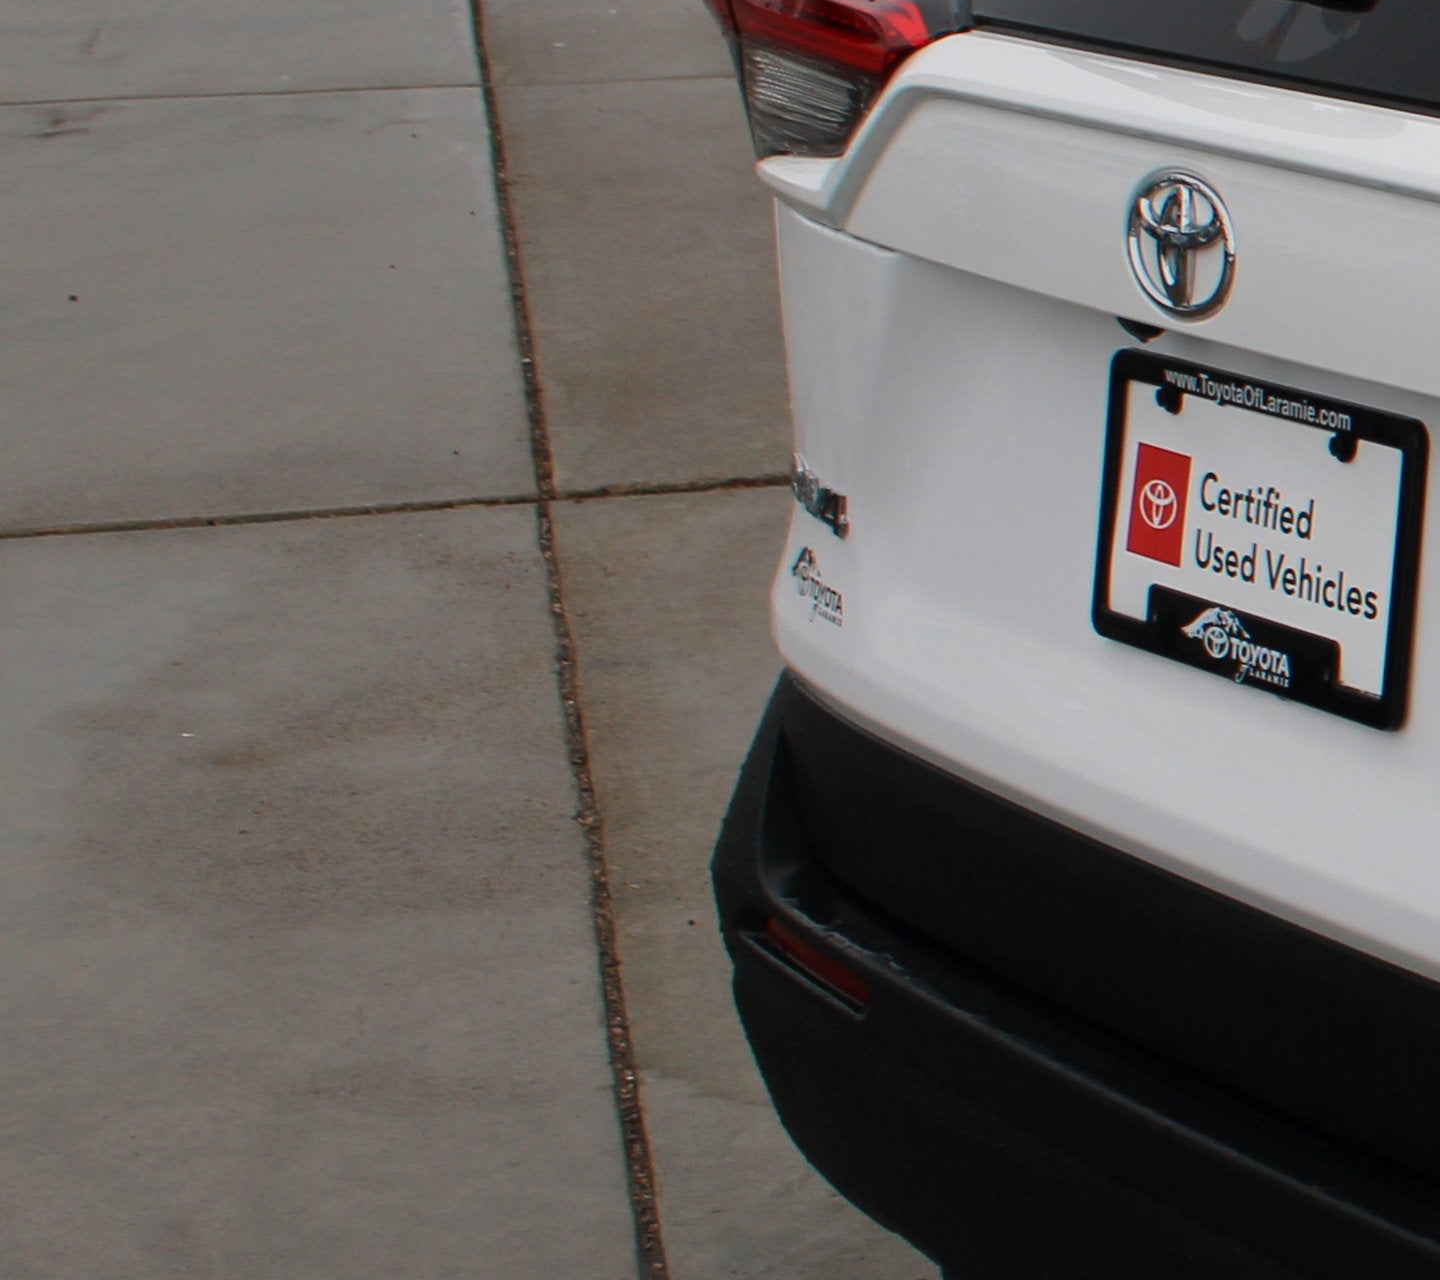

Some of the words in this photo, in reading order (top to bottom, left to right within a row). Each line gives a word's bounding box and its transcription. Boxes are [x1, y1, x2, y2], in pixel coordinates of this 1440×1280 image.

[1164, 368, 1351, 432] www.ToyotaOfLaramie.com
[1200, 472, 1315, 540] Certified
[1194, 528, 1257, 584] Used
[1265, 549, 1378, 620] Vehicles
[1230, 636, 1290, 677] TOYOTA
